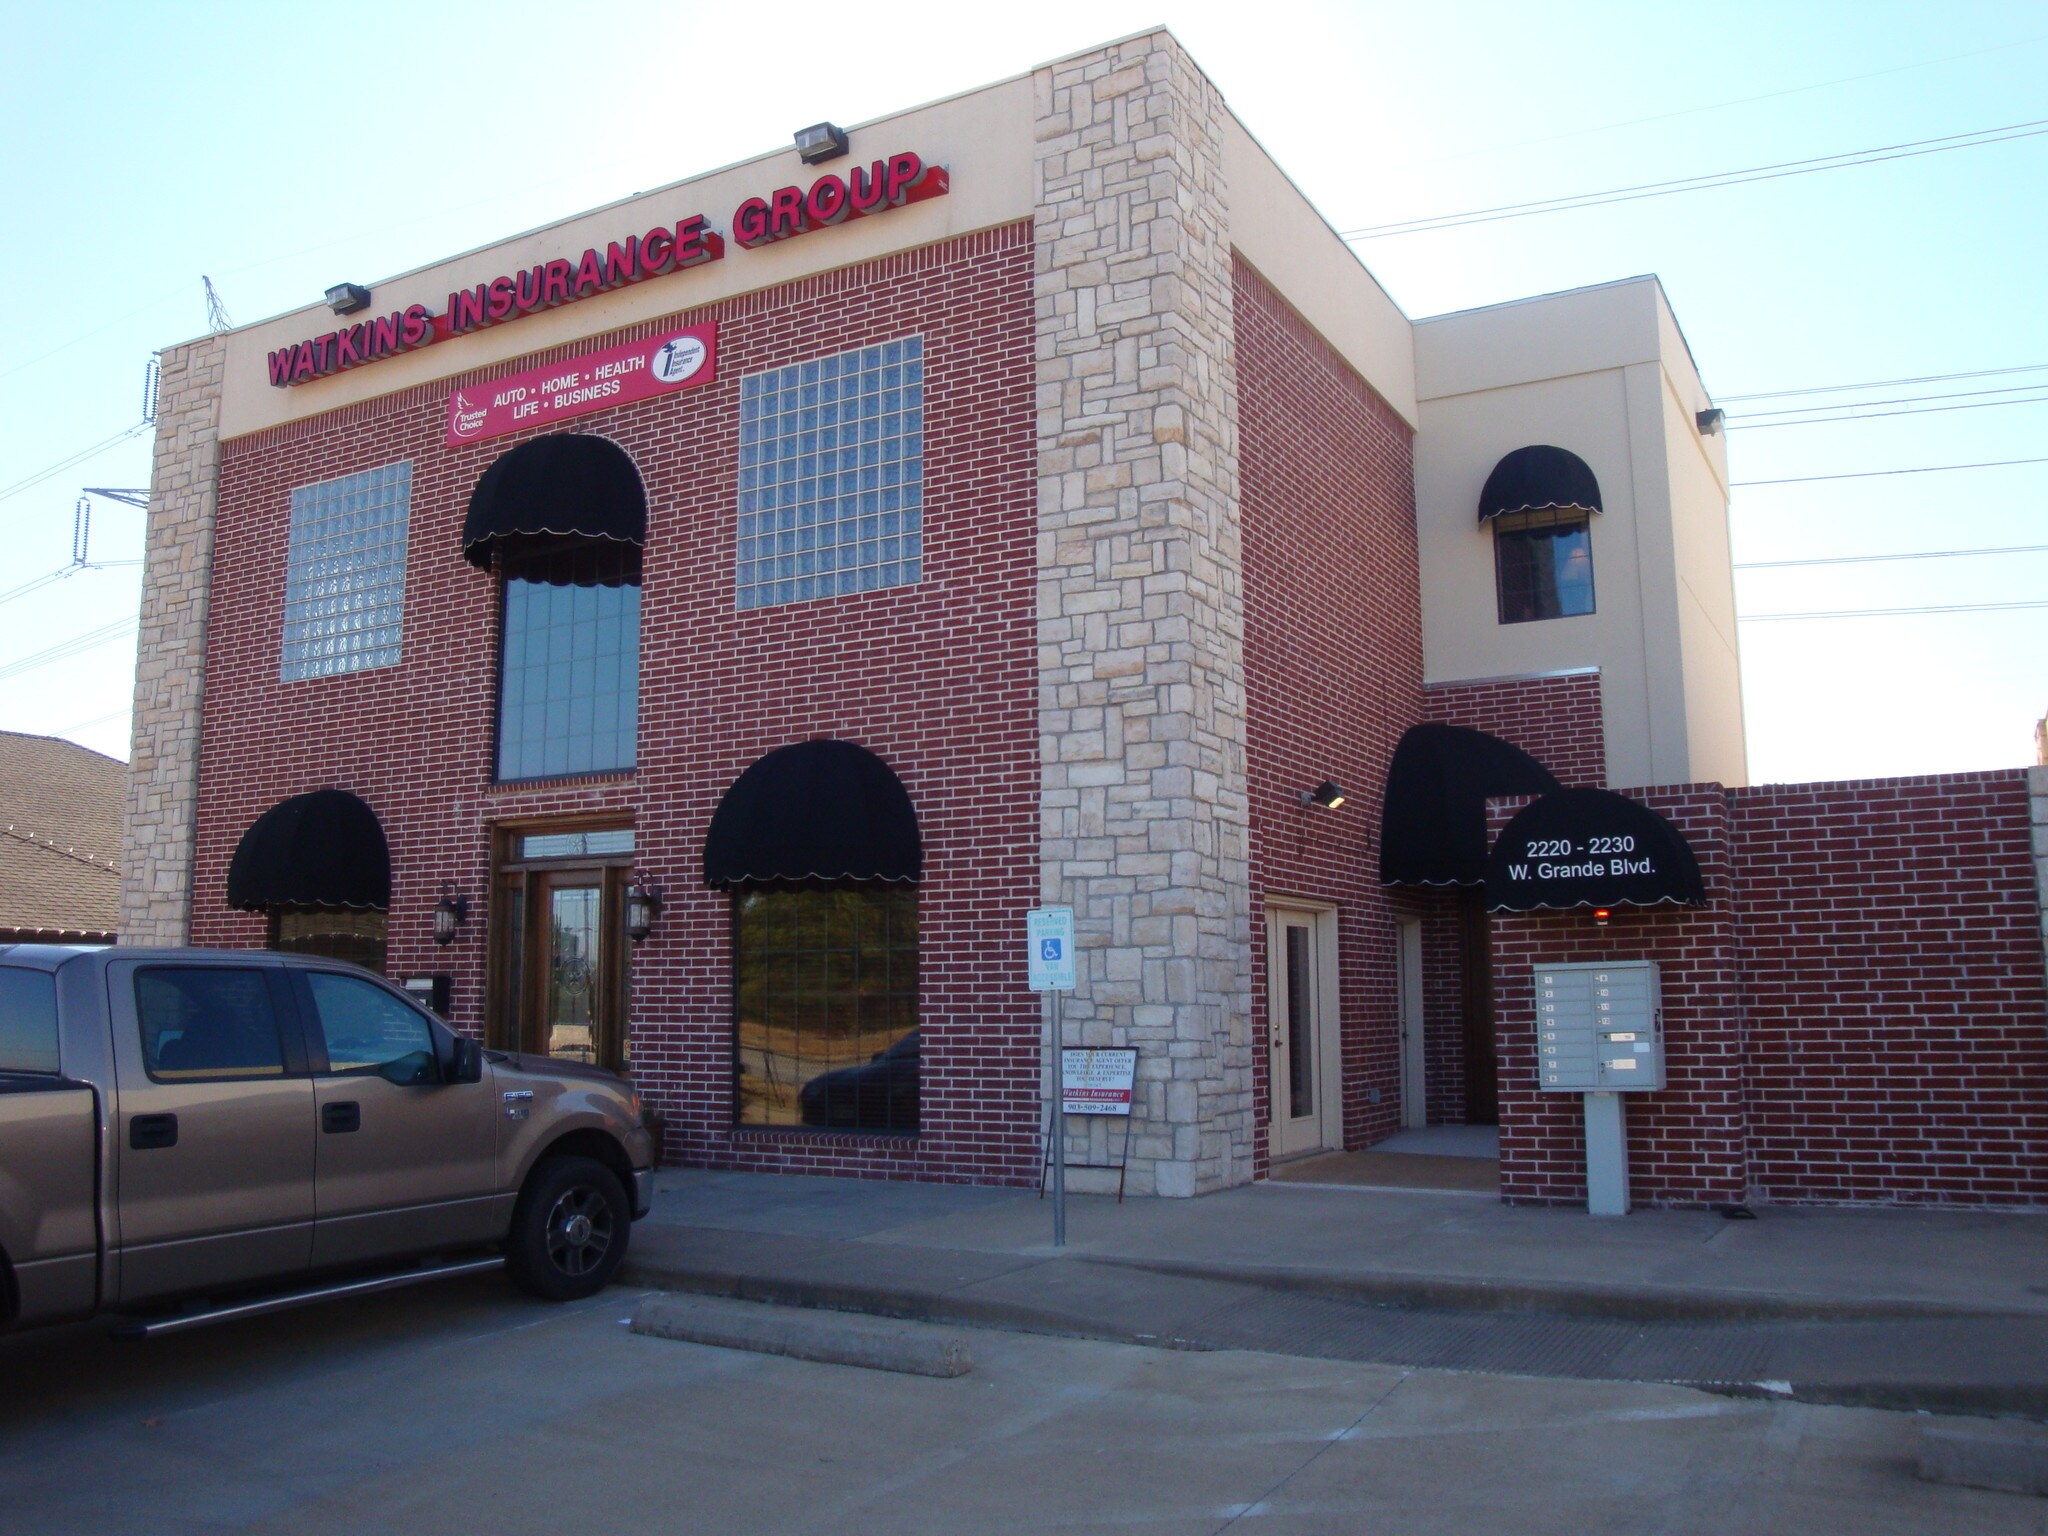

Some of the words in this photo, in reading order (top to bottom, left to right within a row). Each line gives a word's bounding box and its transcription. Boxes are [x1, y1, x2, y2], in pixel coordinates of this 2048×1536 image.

[268, 304, 427, 386] WATKINS
[447, 214, 704, 332] INSURANCE
[732, 151, 921, 241] GROUP
[493, 388, 527, 408] AUTO
[541, 373, 580, 395] HOME
[595, 355, 645, 381] HEALTH
[513, 401, 539, 420] LIFE
[554, 380, 620, 409] BUSINESS
[460, 408, 487, 422] Trusted
[460, 419, 483, 431] Choice
[1526, 840, 1571, 857] 2220
[1589, 836, 1635, 855] 2230
[1509, 864, 1532, 881] W.
[1538, 860, 1605, 879] Grande
[1611, 857, 1656, 876] Blvd.
[1063, 1089, 1089, 1097] Watkins
[1090, 1089, 1124, 1098] Insurance
[1068, 1104, 1117, 1112] 903-509-2468
